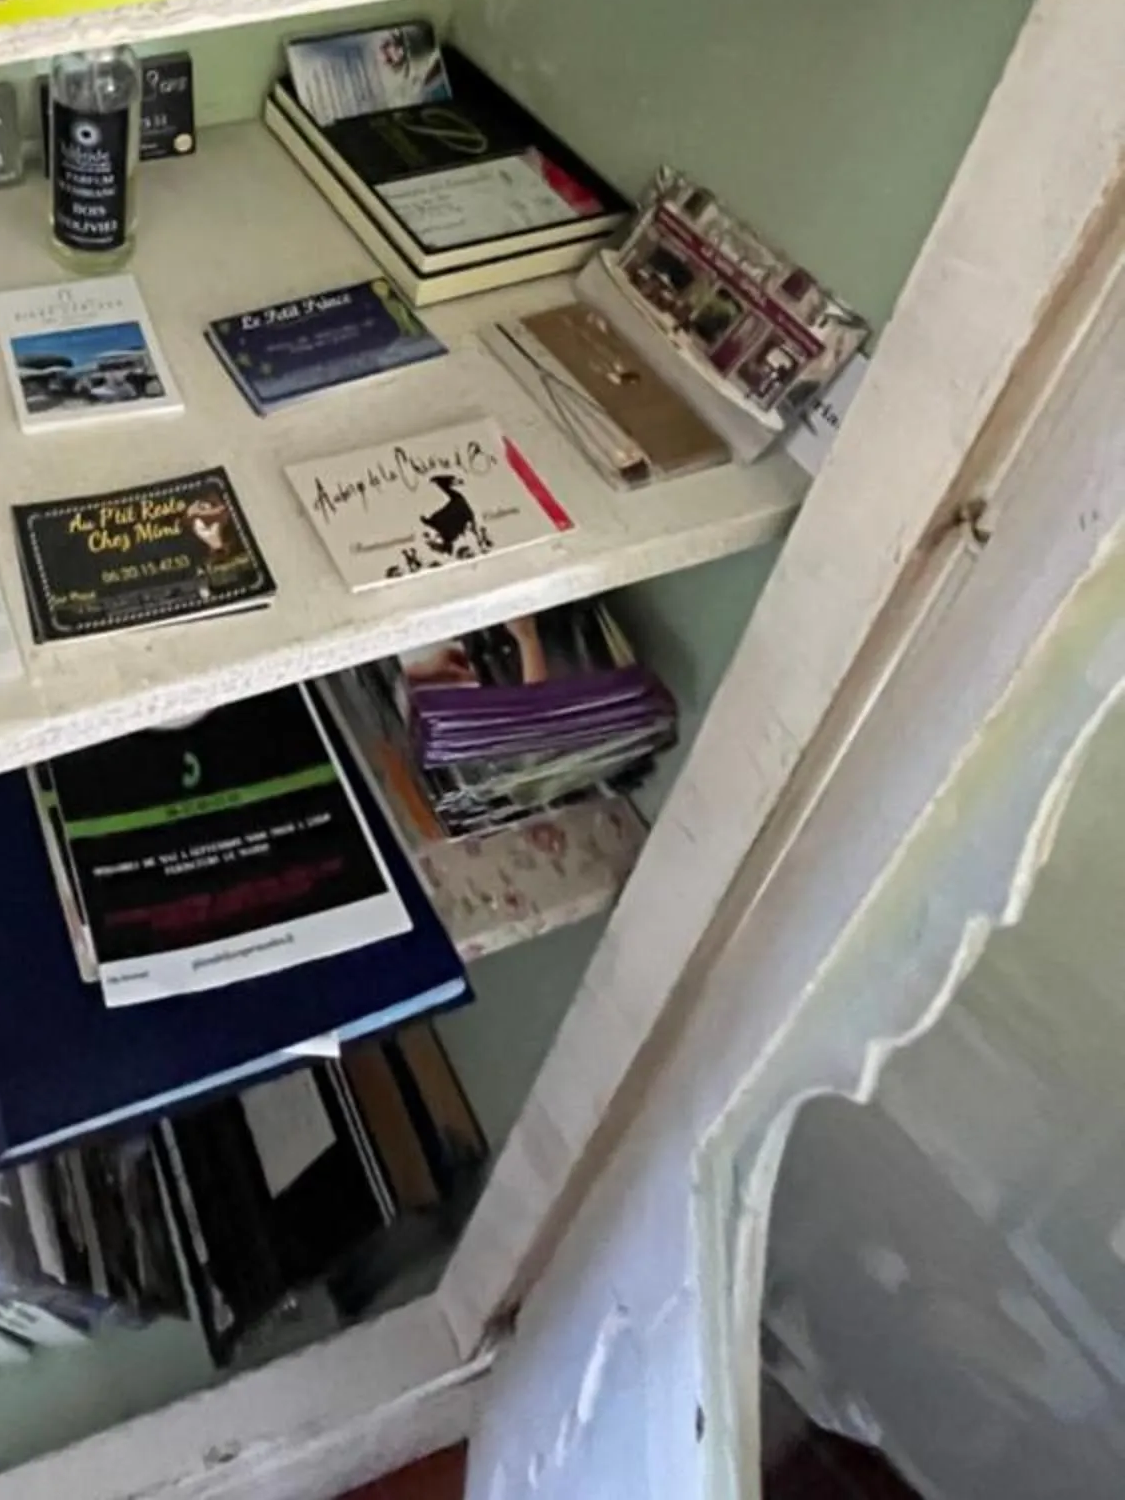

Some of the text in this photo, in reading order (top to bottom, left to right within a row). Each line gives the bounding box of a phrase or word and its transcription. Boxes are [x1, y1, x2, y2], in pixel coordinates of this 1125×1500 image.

[240, 314, 262, 331] Le
[263, 301, 301, 324] Petit
[87, 530, 131, 553] Chez
